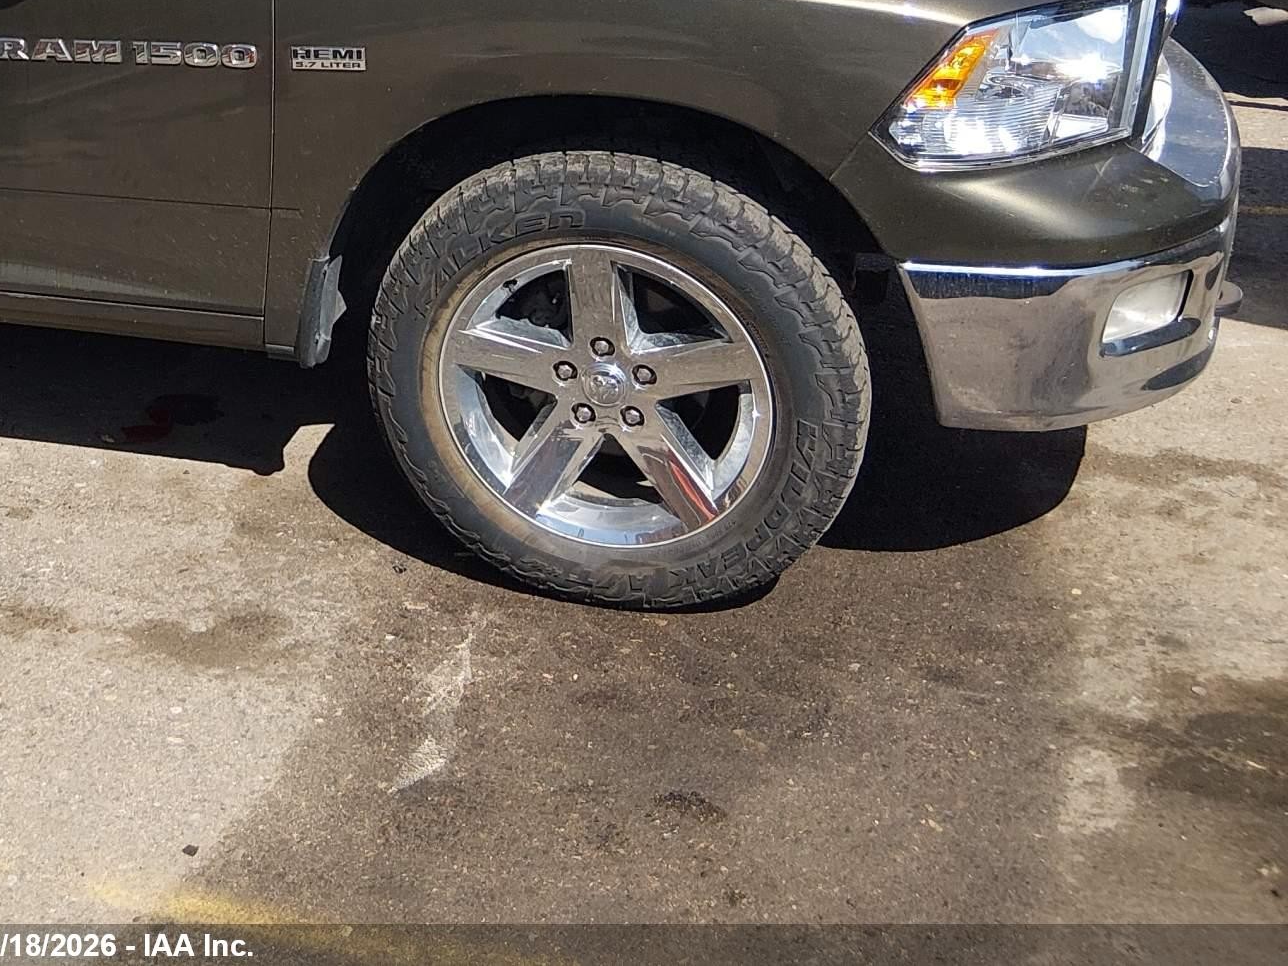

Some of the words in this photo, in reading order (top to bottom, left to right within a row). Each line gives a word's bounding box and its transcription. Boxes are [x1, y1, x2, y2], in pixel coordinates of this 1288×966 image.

[131, 39, 258, 69] 1500
[291, 46, 365, 60] HEMI
[295, 61, 319, 70] 5.7
[320, 61, 362, 71] LITER
